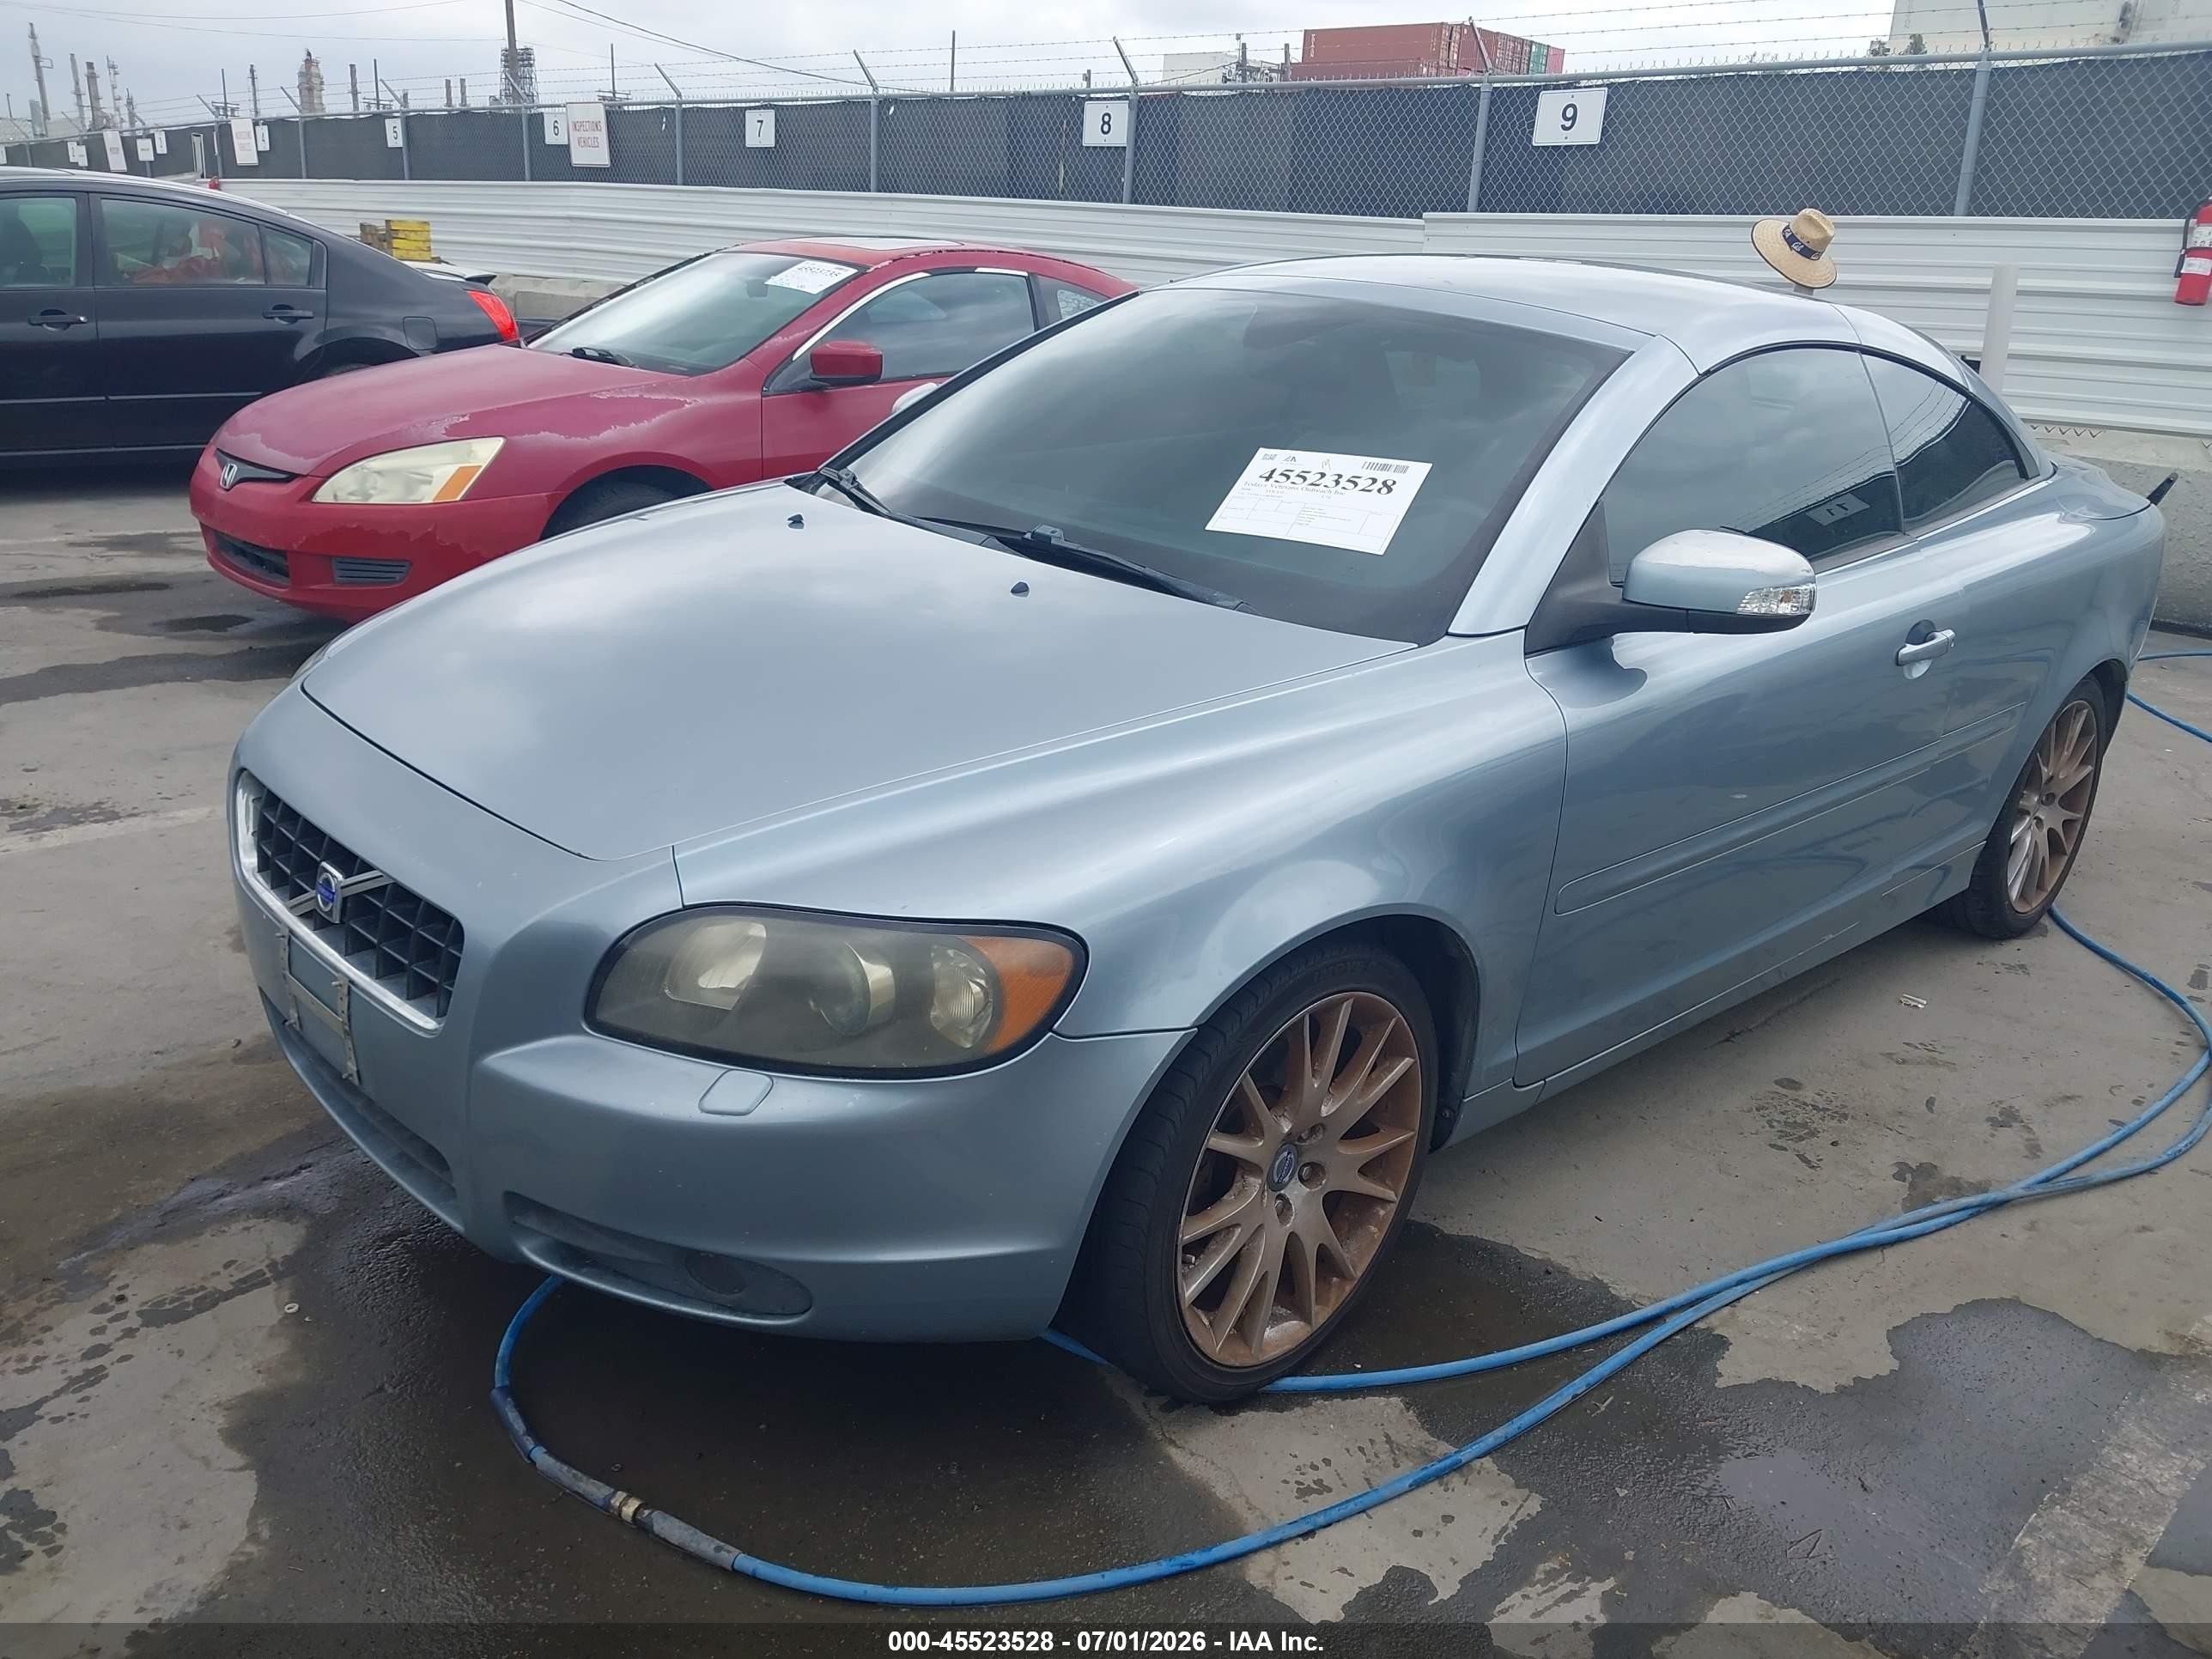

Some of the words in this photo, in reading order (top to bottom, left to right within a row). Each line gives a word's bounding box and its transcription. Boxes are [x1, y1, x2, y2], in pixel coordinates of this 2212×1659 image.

[1100, 112, 1112, 136] 8
[1560, 103, 1578, 131] 9
[392, 125, 398, 140] 5
[552, 119, 560, 137] 6
[757, 119, 764, 138] 7
[577, 137, 599, 148] VEHICLES
[1258, 467, 1397, 495] 45523528
